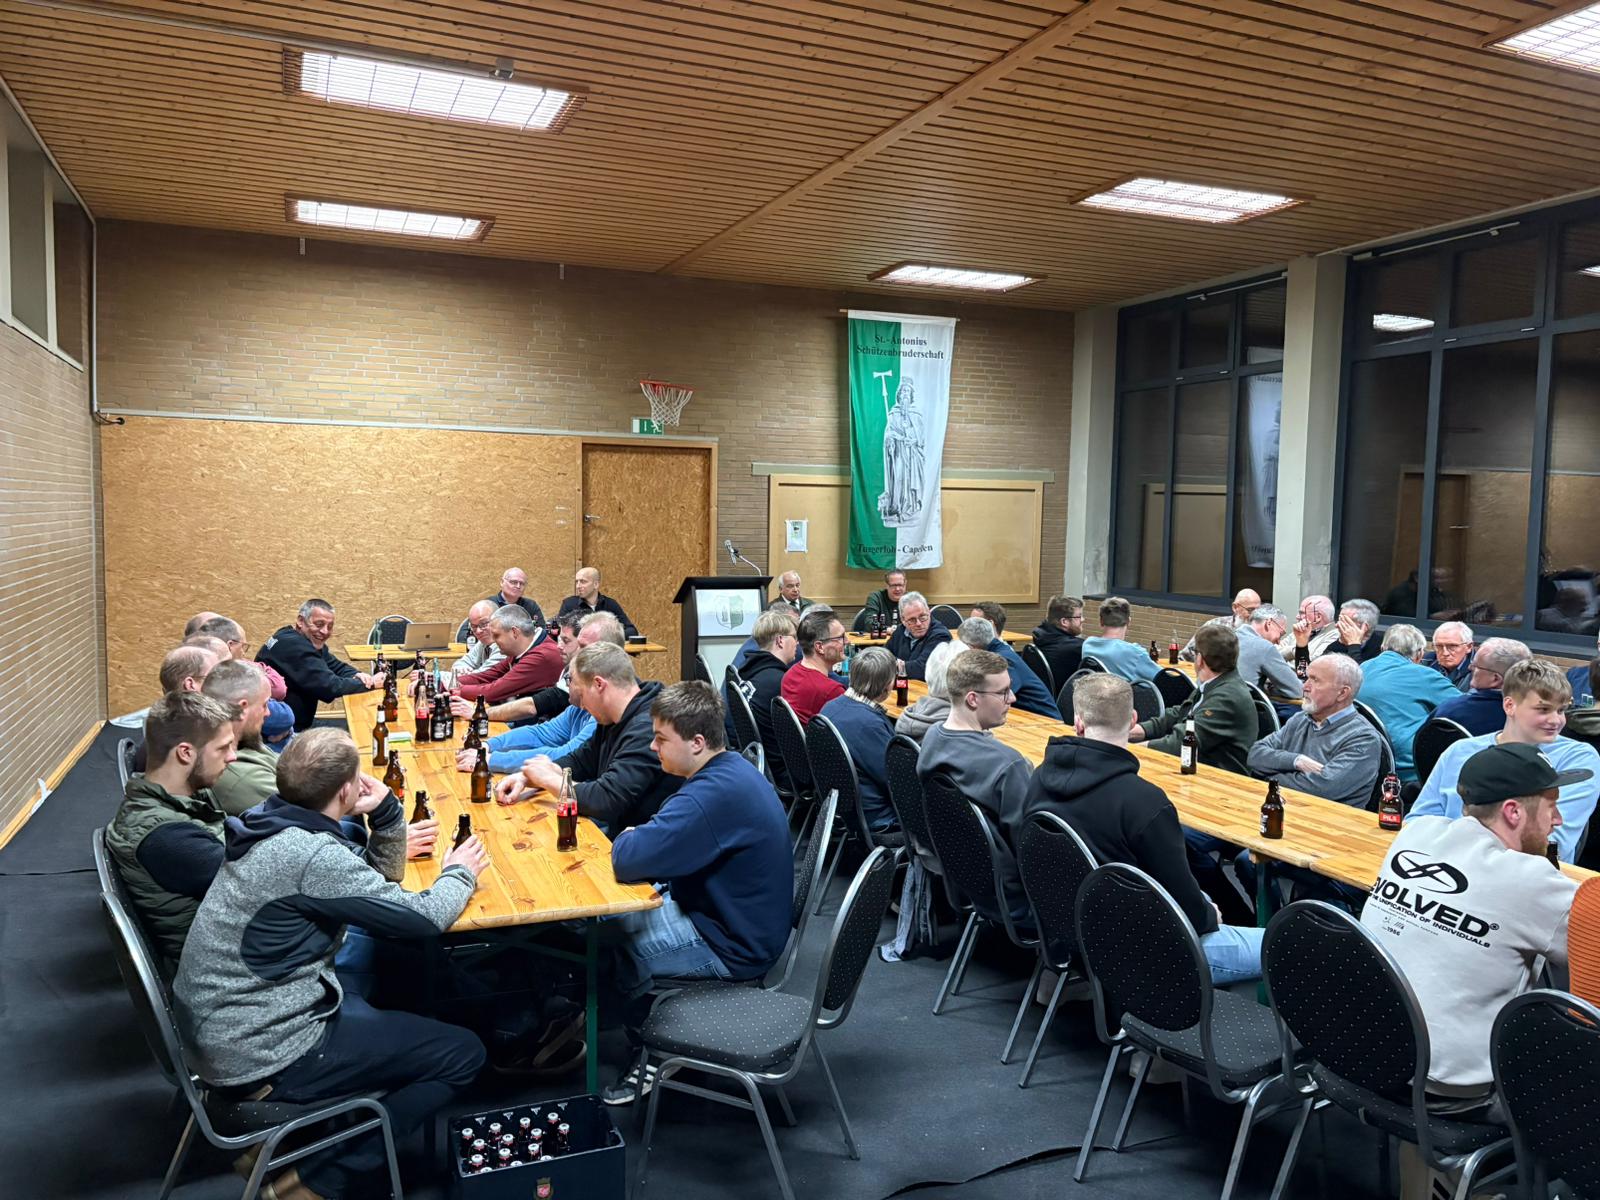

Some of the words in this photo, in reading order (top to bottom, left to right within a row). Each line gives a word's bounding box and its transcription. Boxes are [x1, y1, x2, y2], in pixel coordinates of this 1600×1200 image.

[856, 344, 944, 359] Schützenbruderschaft
[1379, 897, 1418, 919] UNIFICATION
[1432, 921, 1491, 949] INDIVIDUALS
